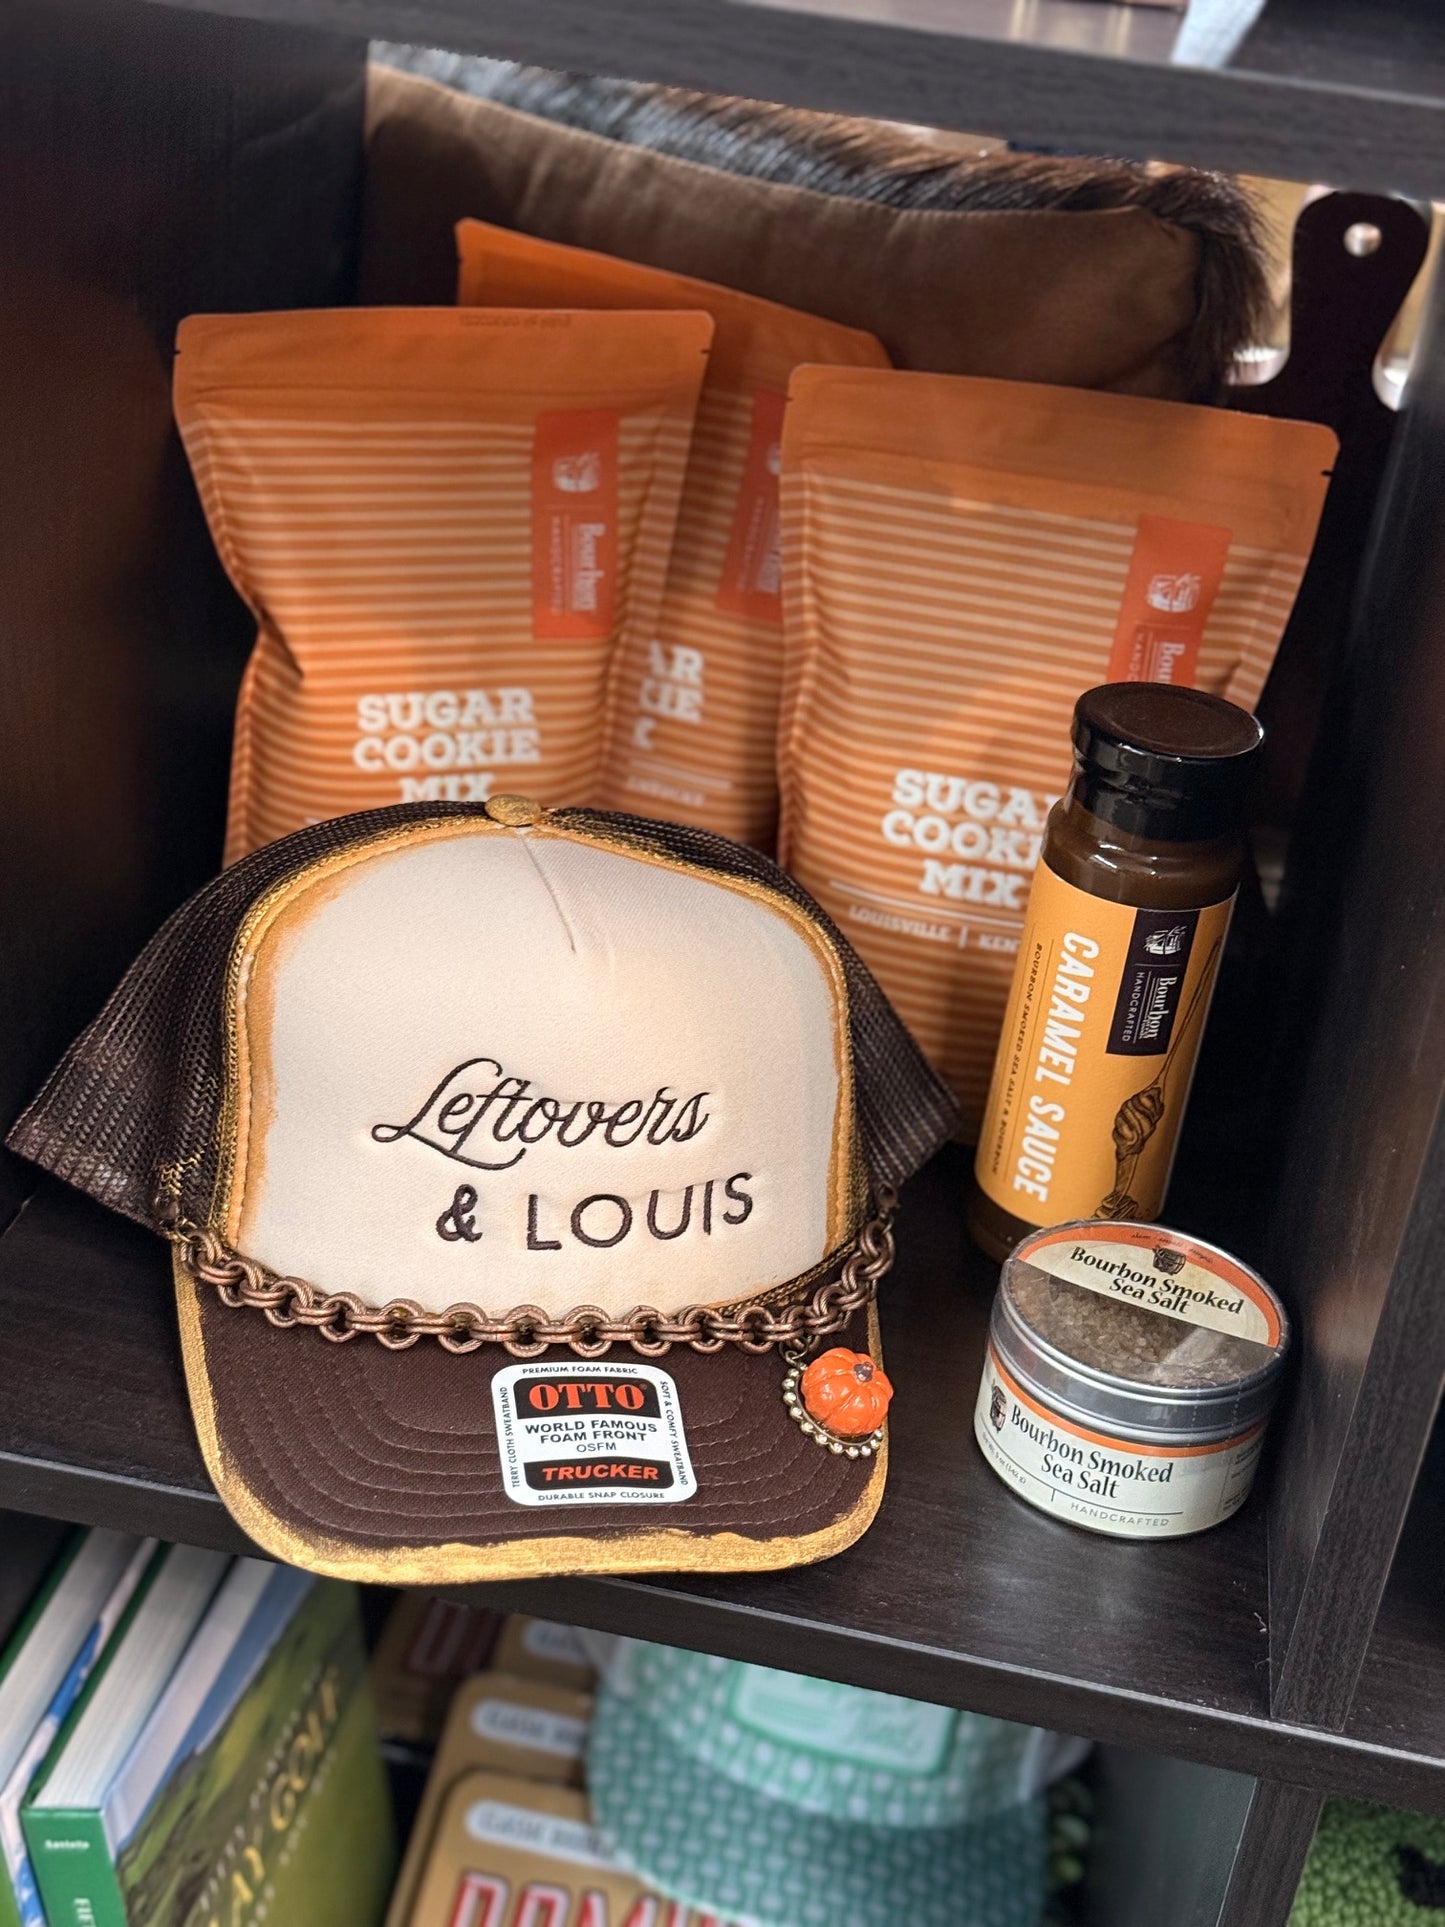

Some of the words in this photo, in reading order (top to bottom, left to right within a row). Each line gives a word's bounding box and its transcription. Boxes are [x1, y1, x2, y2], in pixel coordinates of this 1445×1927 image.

[356, 686, 537, 733] SUGAR
[352, 728, 542, 772] COOKIE
[399, 772, 496, 803] MIX
[918, 858, 1025, 910] MIX
[849, 903, 951, 942] LOUISVILLE
[1026, 943, 1042, 1001] BOURBON
[1015, 1003, 1030, 1052] SMOKED
[1035, 931, 1099, 1086] CARAMEL
[1121, 971, 1146, 1043] HANDCRAFTED
[1149, 976, 1178, 1040] Bourbon
[1010, 1054, 1021, 1075] SEA
[371, 1057, 711, 1170] Leftovers
[1013, 1094, 1066, 1202] SAUCE
[435, 1183, 484, 1243] &
[526, 1172, 754, 1251] LOUIS
[1070, 1246, 1157, 1288] Bourbon
[1159, 1278, 1245, 1315] Smoked
[1109, 1278, 1146, 1300] Sea
[1147, 1290, 1190, 1315] Salt
[522, 1366, 569, 1374] PREMIUM
[604, 1366, 638, 1374] FABRIC
[660, 1380, 671, 1399] SOFT
[500, 1386, 514, 1436] SWEATBAND
[528, 1383, 645, 1411] OTTO
[525, 1421, 585, 1434] WORLD
[591, 1420, 658, 1433] FAMOUS
[541, 1432, 587, 1444] FOAM
[593, 1430, 647, 1442] FRONT
[666, 1409, 678, 1438] COMFY
[1010, 1404, 1084, 1466] Bourbon
[1087, 1450, 1175, 1483] Smoked
[507, 1439, 517, 1464] CLOTH
[576, 1442, 617, 1453] OSFM
[671, 1440, 689, 1486] SWEATBAND
[512, 1465, 521, 1488] TERRY
[542, 1464, 660, 1481] TRUCKER
[1041, 1453, 1074, 1485] Sea
[1077, 1470, 1120, 1499] Salt
[538, 1492, 585, 1501] DURABLE
[588, 1491, 617, 1499] SNAP
[621, 1491, 665, 1499] CLOSURE
[1070, 1502, 1170, 1527] HANDCRAFTED
